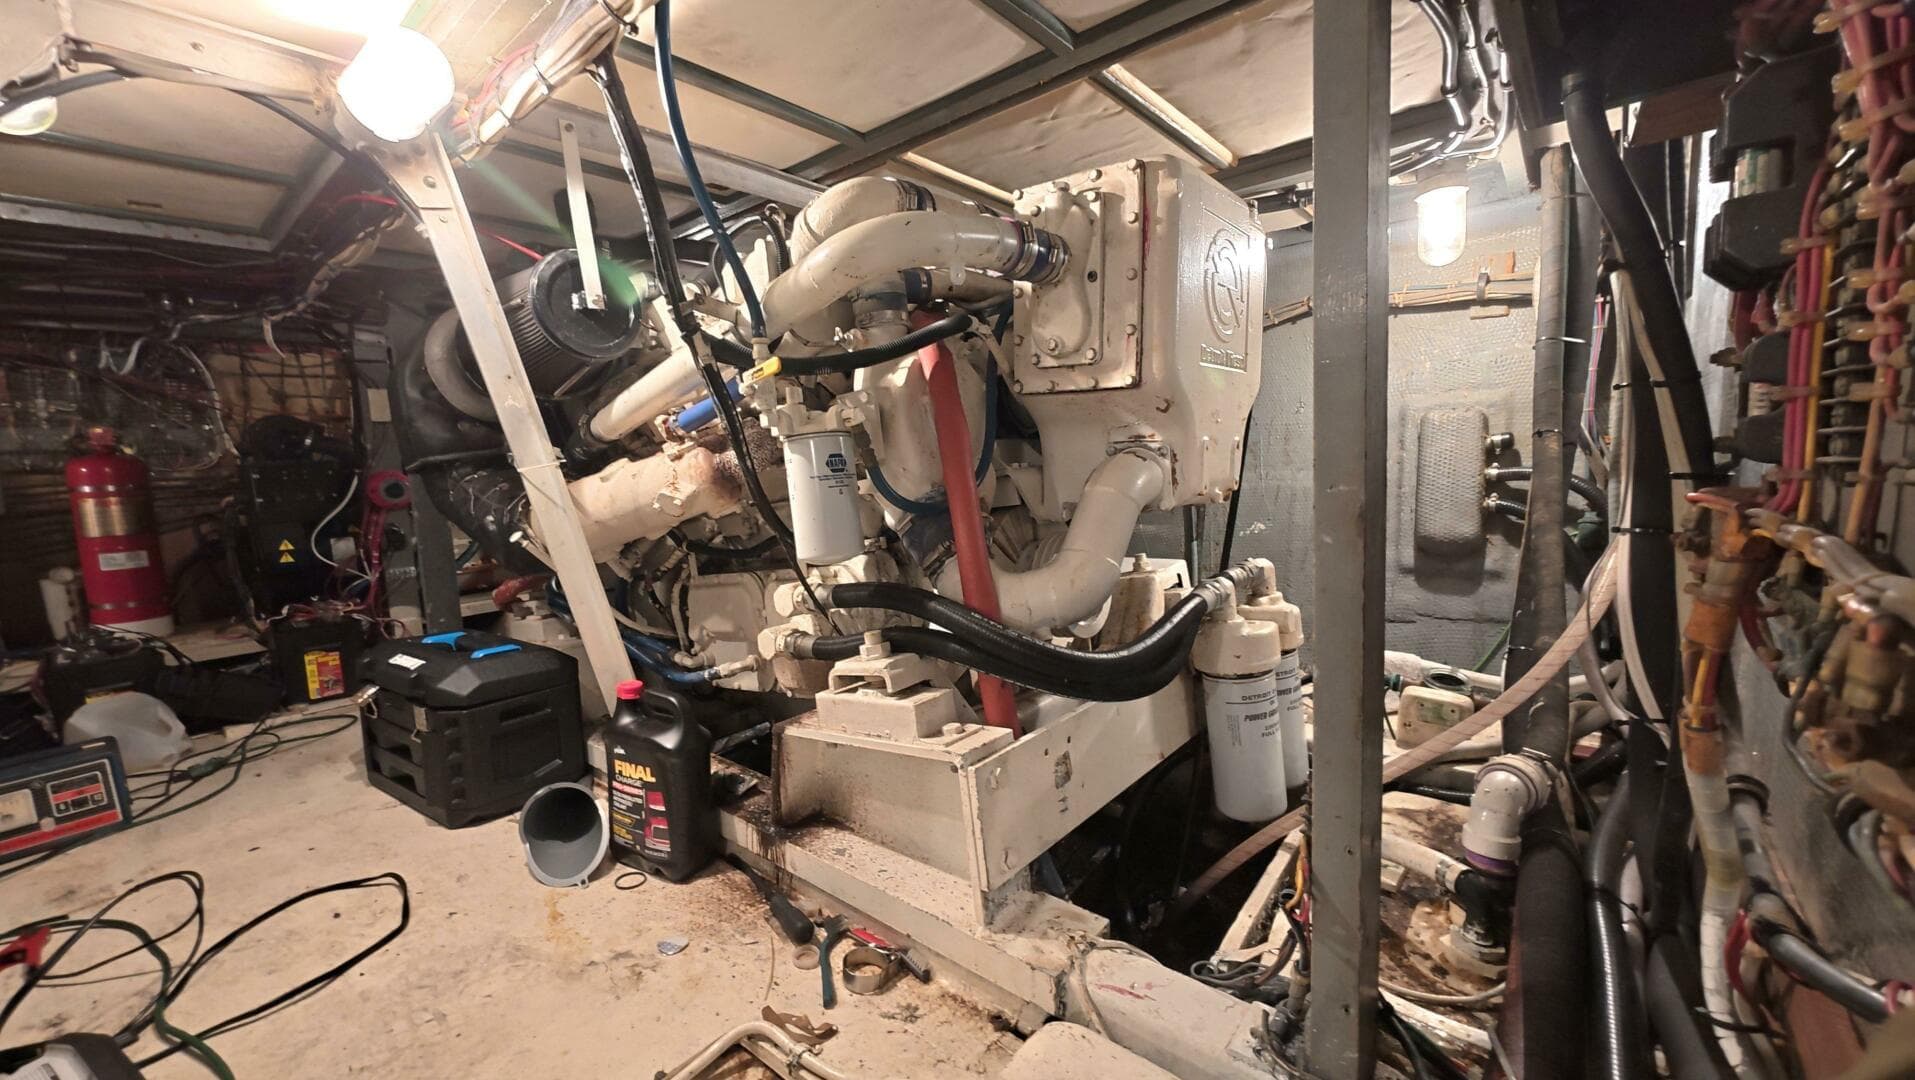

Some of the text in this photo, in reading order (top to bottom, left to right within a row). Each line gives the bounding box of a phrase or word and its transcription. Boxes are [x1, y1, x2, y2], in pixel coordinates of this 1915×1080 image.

[1241, 692, 1270, 701] DETROIT
[1244, 711, 1267, 722] POWER
[614, 759, 656, 782] FINAL
